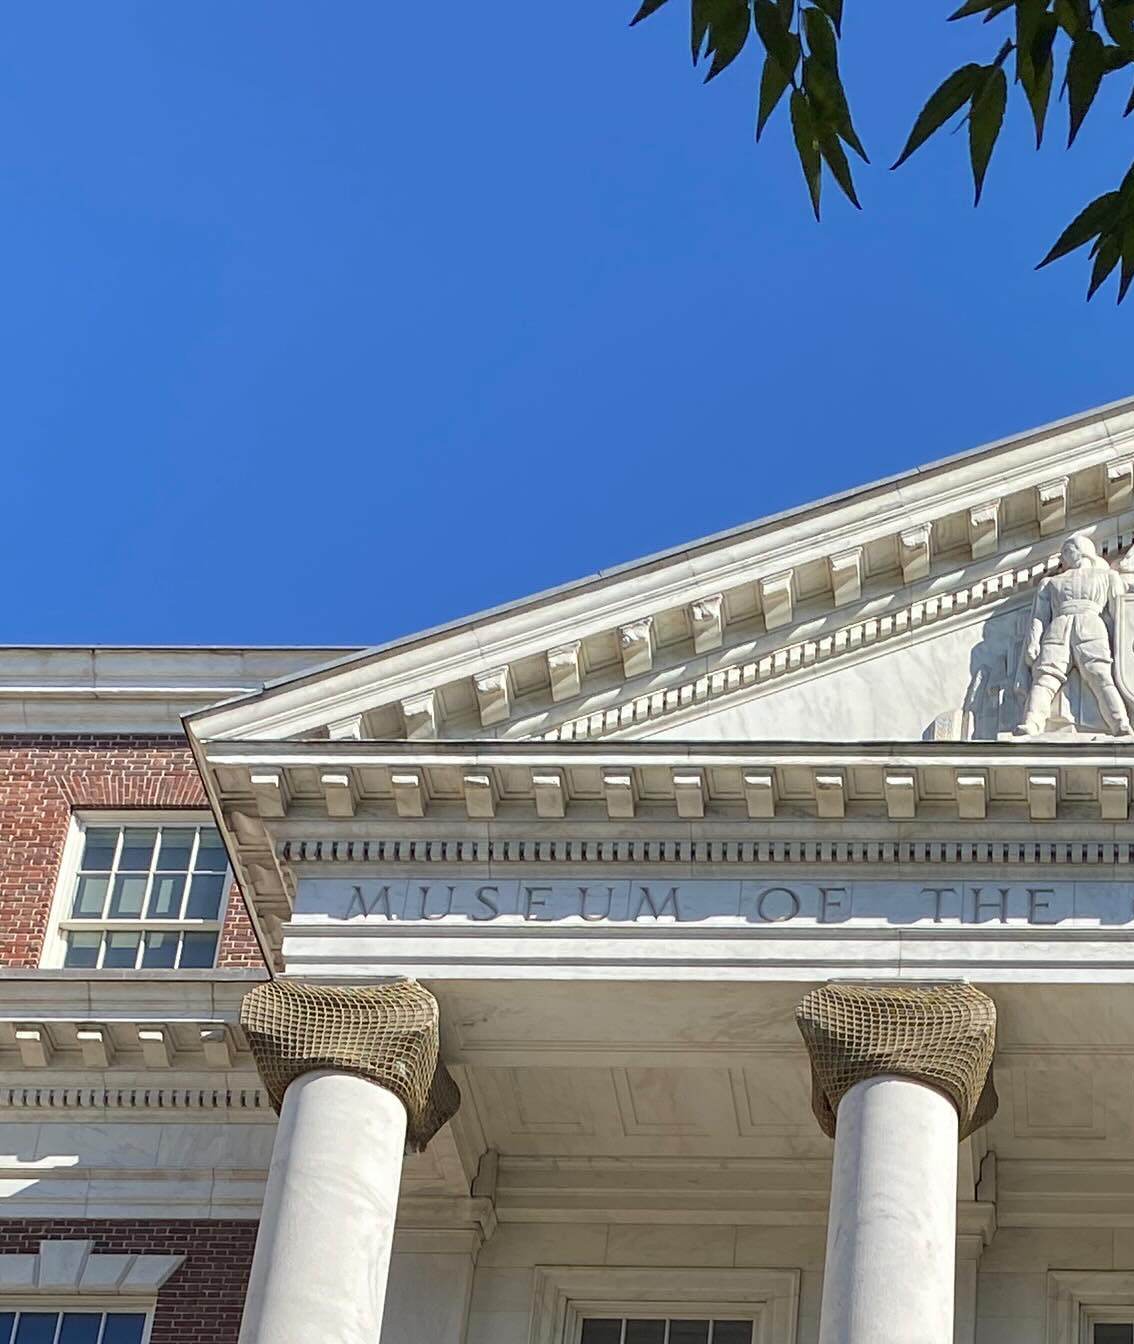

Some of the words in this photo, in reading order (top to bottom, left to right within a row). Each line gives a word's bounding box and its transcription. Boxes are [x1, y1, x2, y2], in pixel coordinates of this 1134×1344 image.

[344, 886, 680, 922] MUSEUM
[758, 887, 847, 924] OF
[920, 888, 1057, 925] THE
